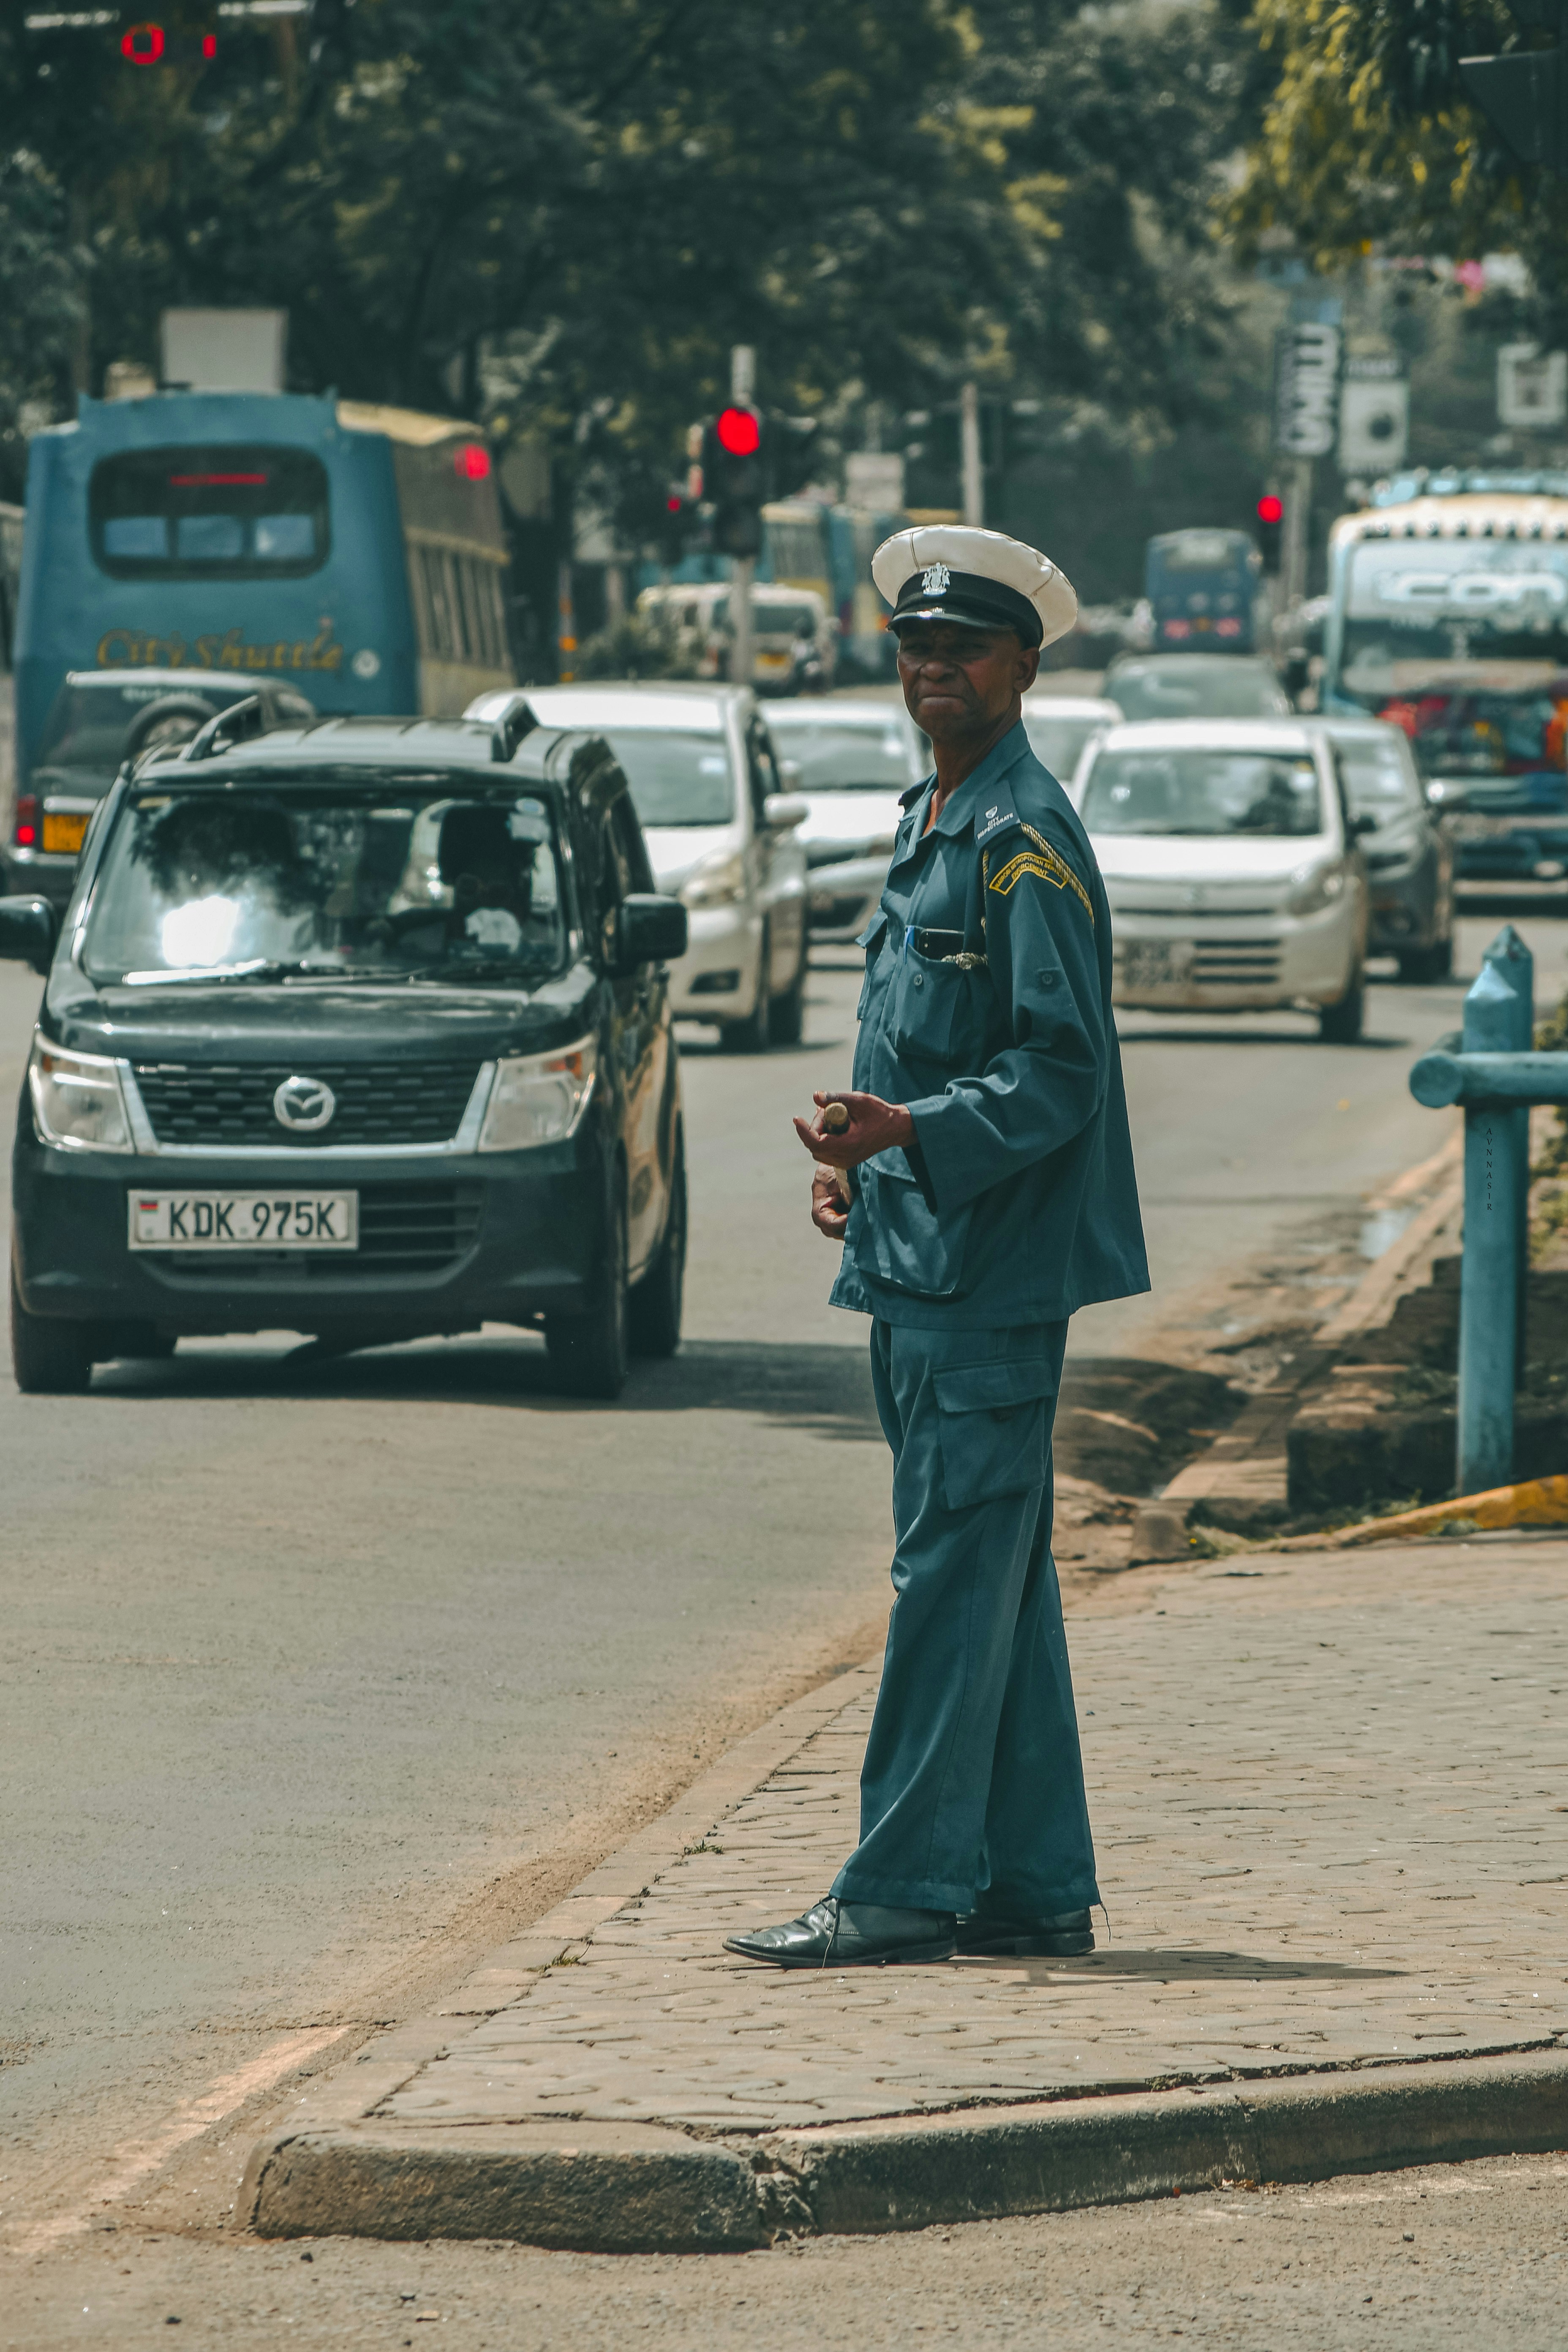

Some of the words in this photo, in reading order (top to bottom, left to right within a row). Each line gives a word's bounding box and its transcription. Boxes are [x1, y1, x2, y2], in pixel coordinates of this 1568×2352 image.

[97, 628, 186, 669] City
[193, 627, 344, 670] Shuttle
[988, 815, 999, 827] CITY
[170, 1201, 234, 1237] KDK
[253, 1201, 335, 1237] 975K
